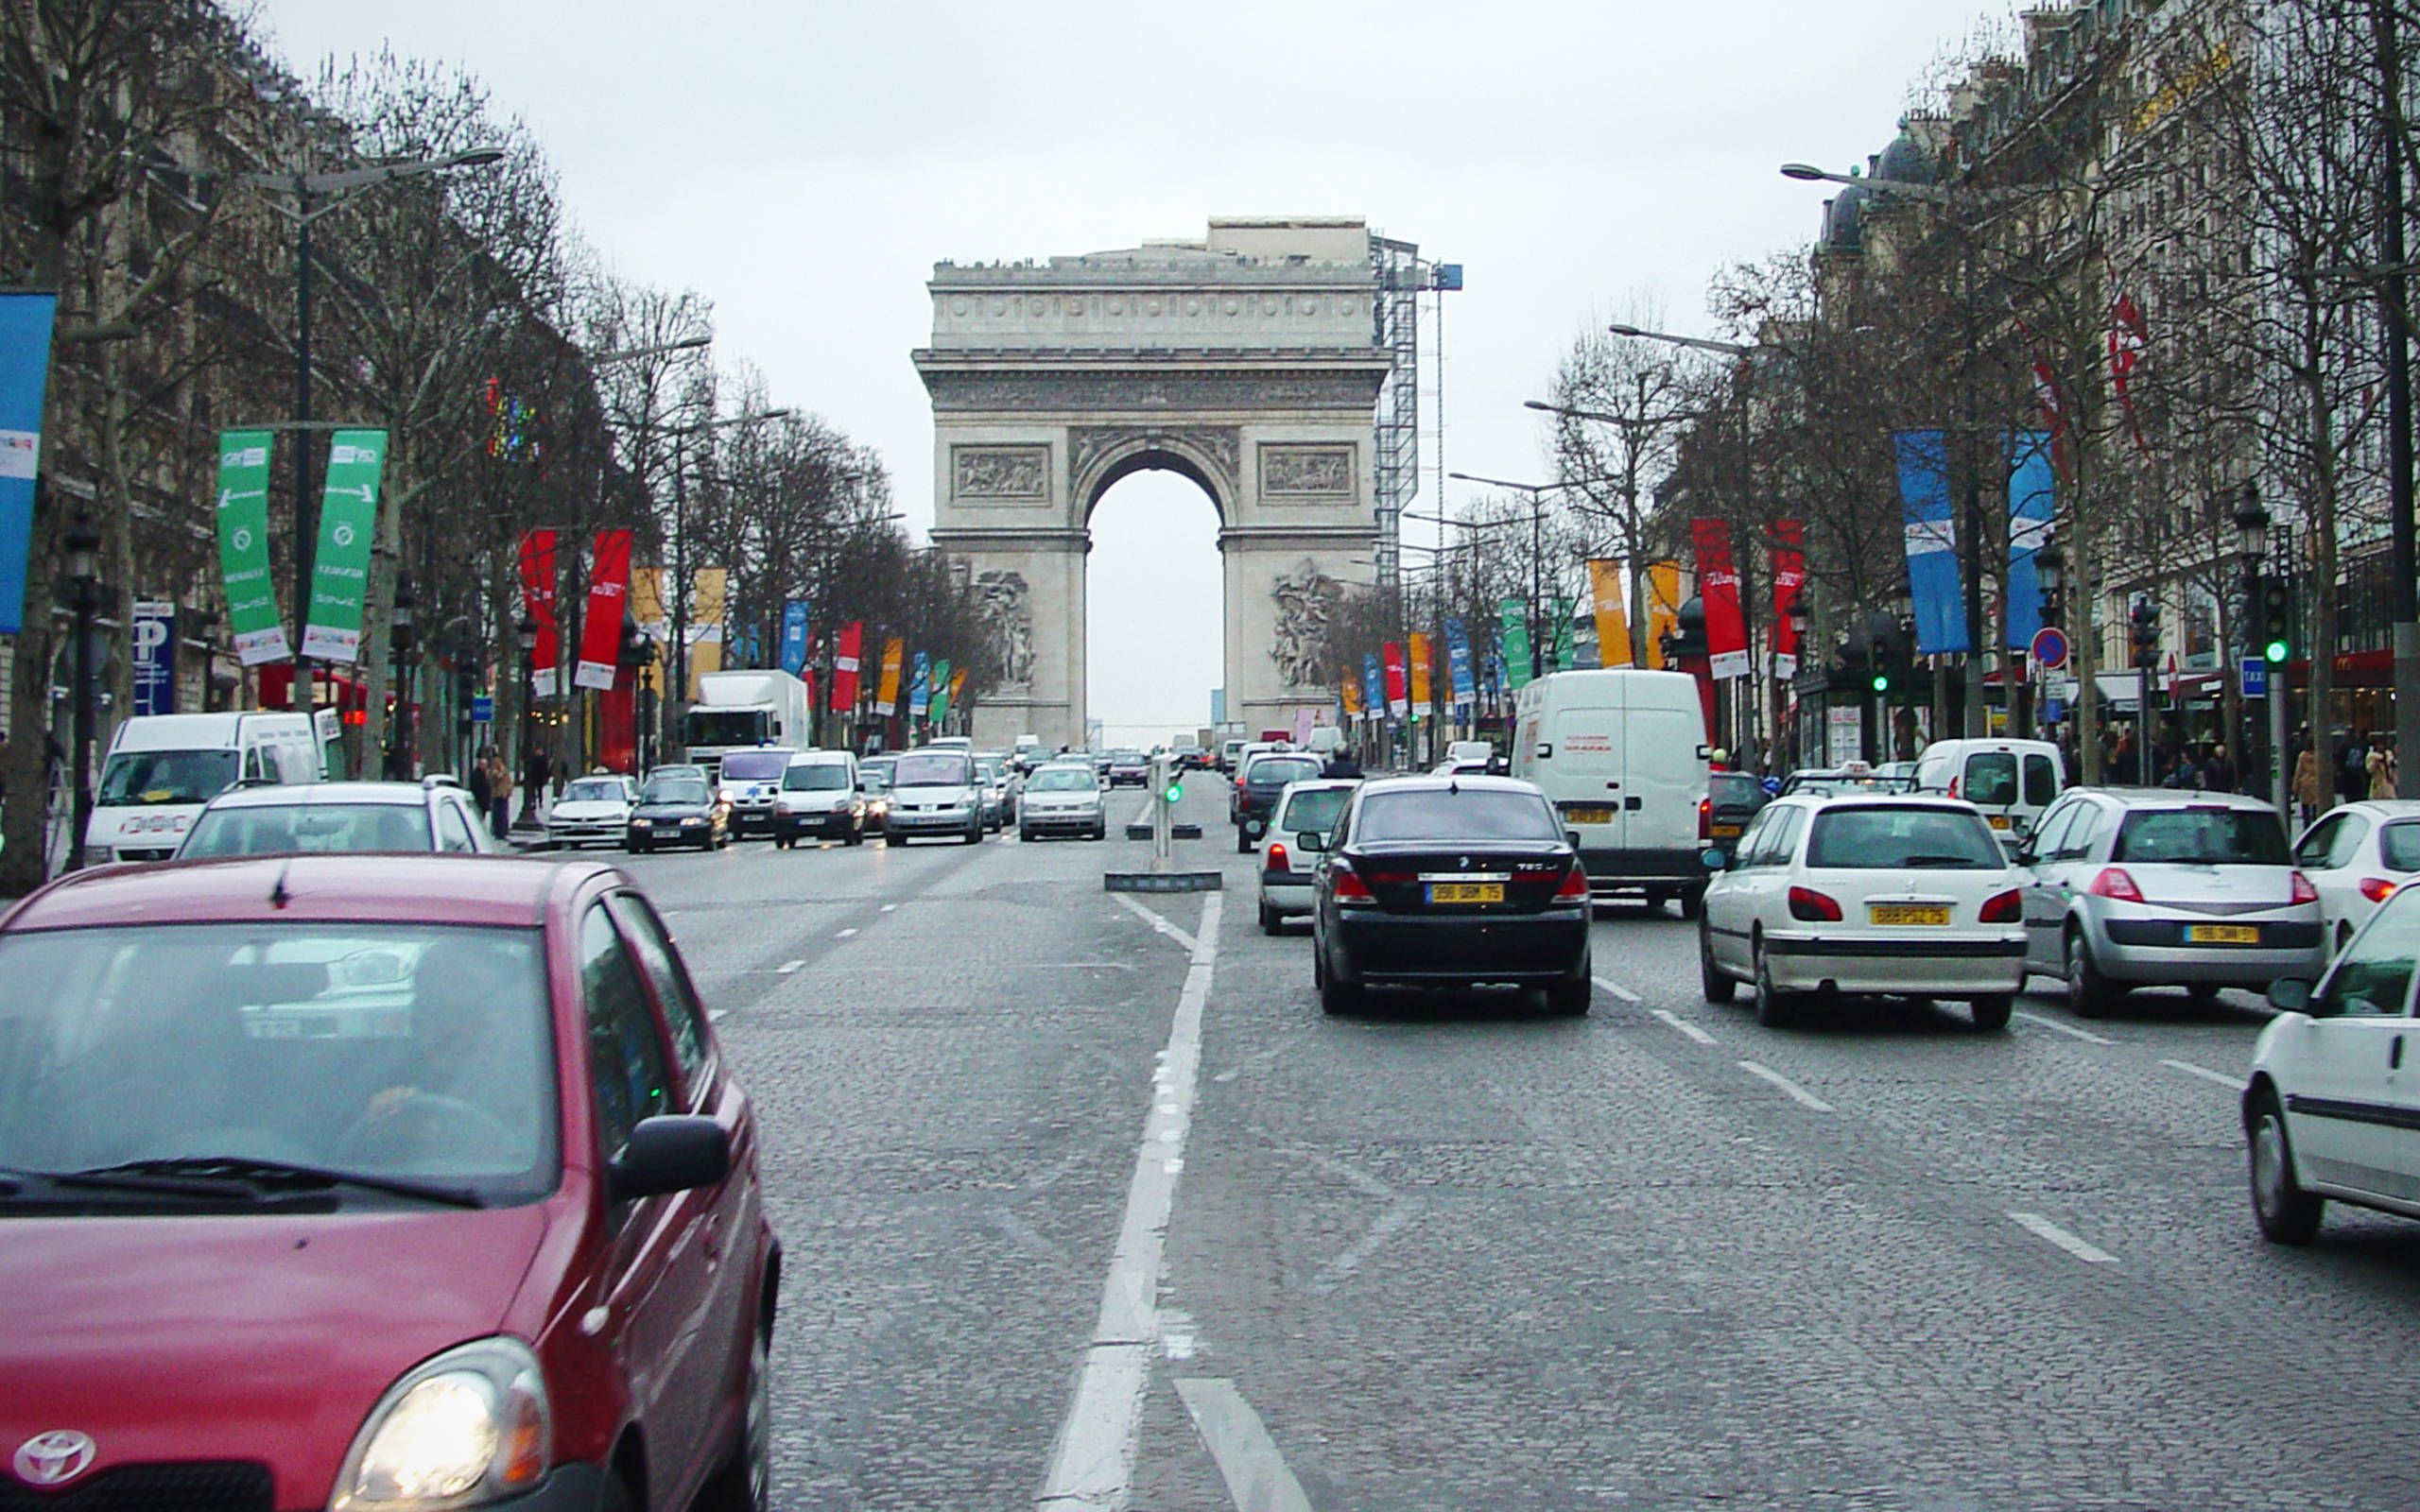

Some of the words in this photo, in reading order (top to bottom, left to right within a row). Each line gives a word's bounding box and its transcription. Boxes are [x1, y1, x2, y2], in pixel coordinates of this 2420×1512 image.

[136, 619, 167, 661] P
[1484, 885, 1500, 900] 75
[1927, 908, 1945, 923] 75
